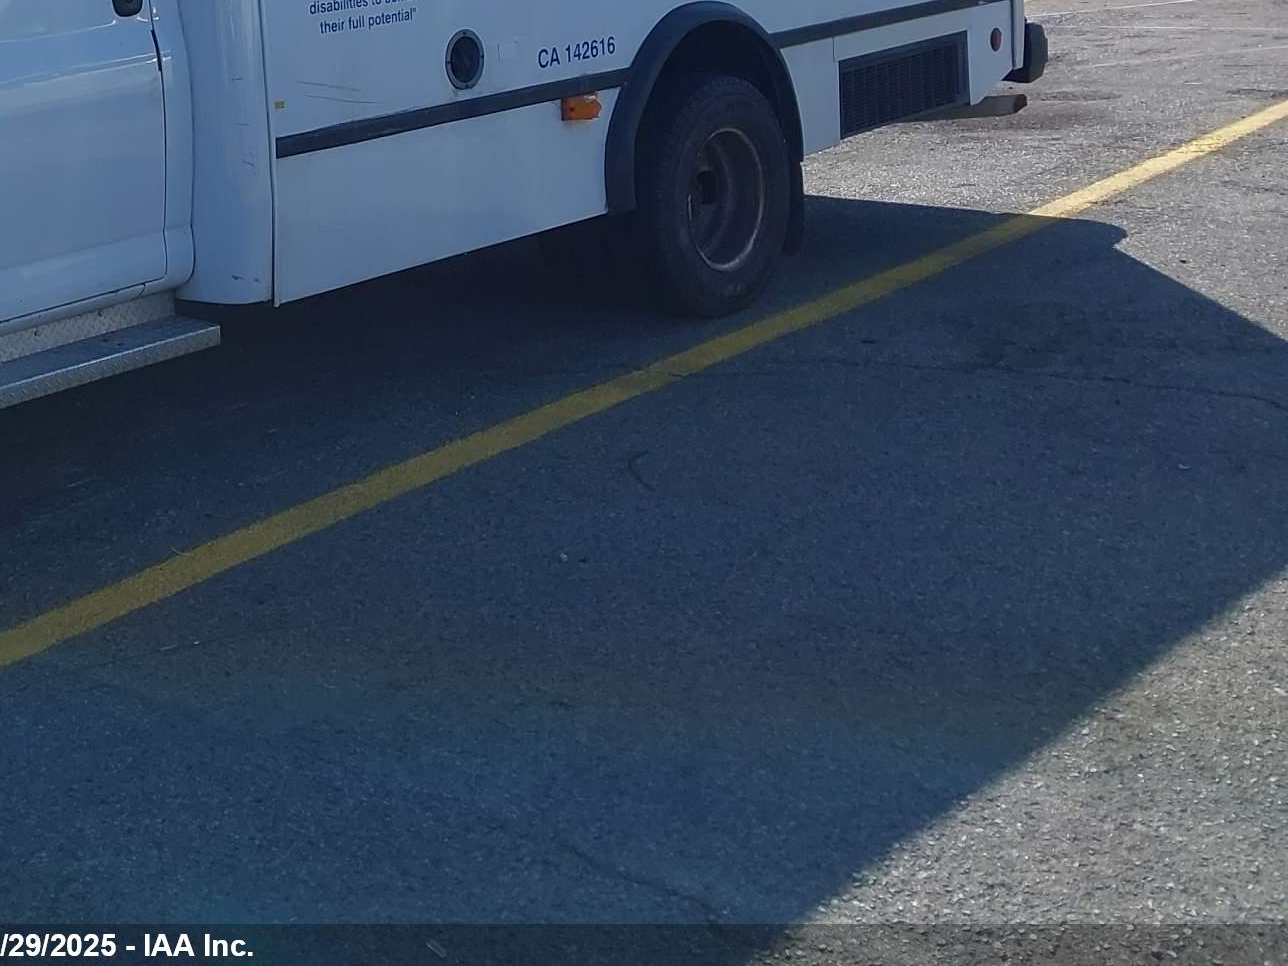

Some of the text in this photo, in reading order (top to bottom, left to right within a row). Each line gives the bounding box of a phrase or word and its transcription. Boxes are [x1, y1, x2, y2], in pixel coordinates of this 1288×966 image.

[319, 7, 417, 35] their full potential"
[537, 36, 616, 69] CA 142616
